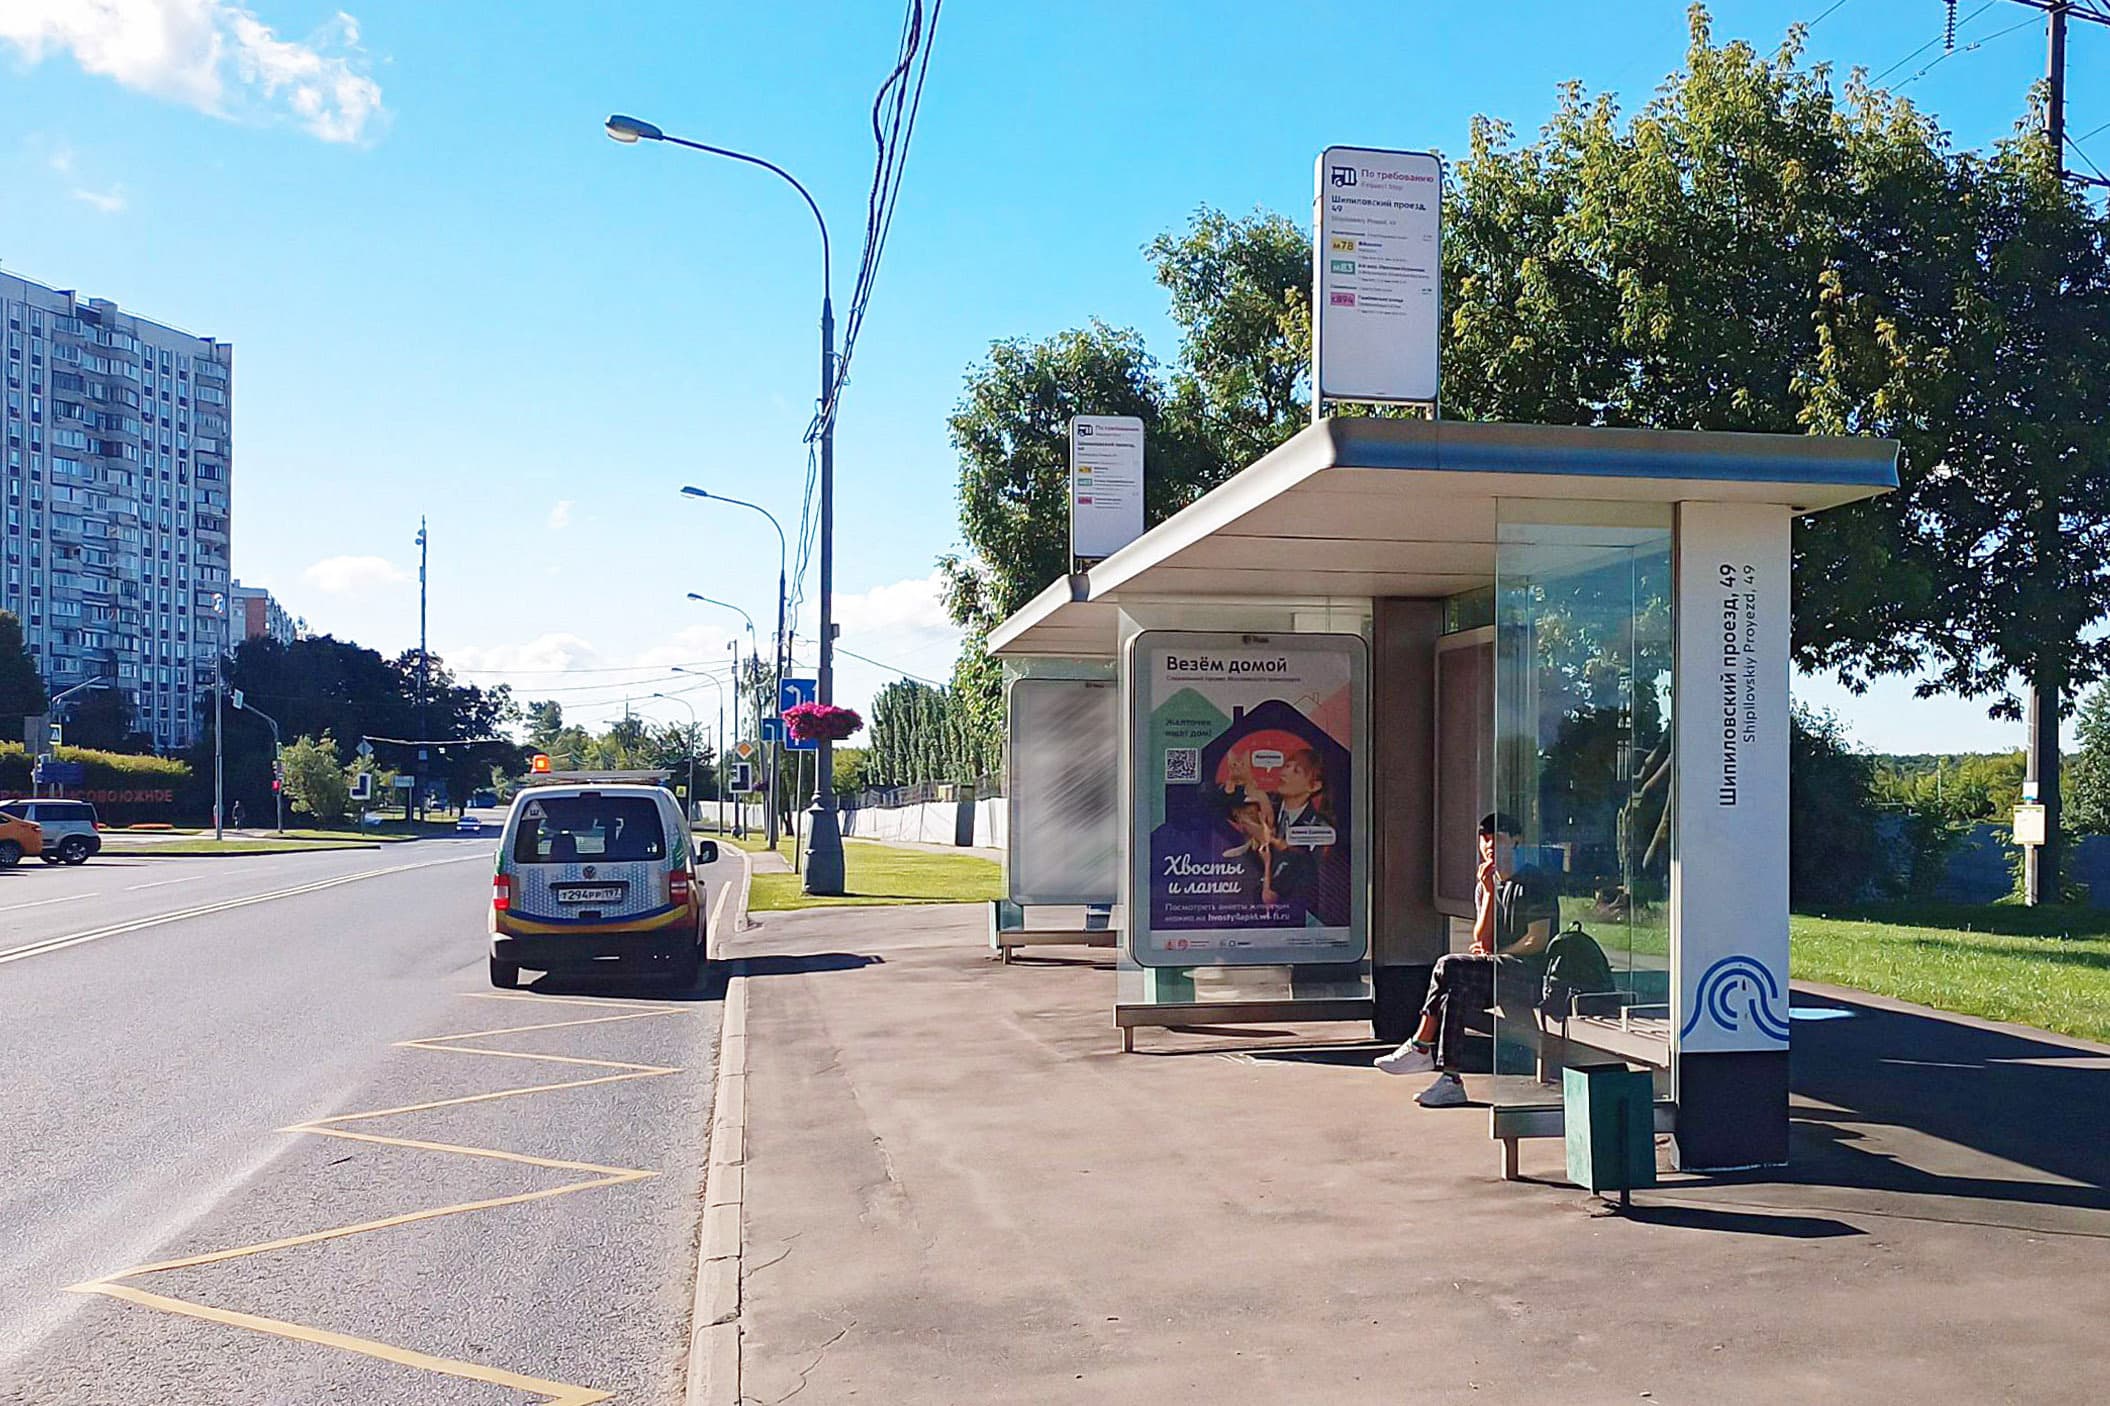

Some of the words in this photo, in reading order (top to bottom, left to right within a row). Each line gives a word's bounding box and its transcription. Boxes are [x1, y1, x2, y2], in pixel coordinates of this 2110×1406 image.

[1361, 169, 1375, 178] По
[1377, 171, 1434, 183] требованию
[1719, 564, 1737, 588] 49
[1743, 564, 1756, 585] 49
[1723, 592, 1741, 667] проезд,
[1743, 588, 1758, 653] Proyezd,
[1166, 656, 1225, 671] Везём
[1228, 657, 1288, 674] домой
[1743, 656, 1758, 743] Shipilovskiy
[1719, 673, 1737, 806] Шипиловский
[1163, 853, 1246, 876] Хвосты
[1168, 881, 1182, 894] и
[1184, 881, 1242, 894] лапки
